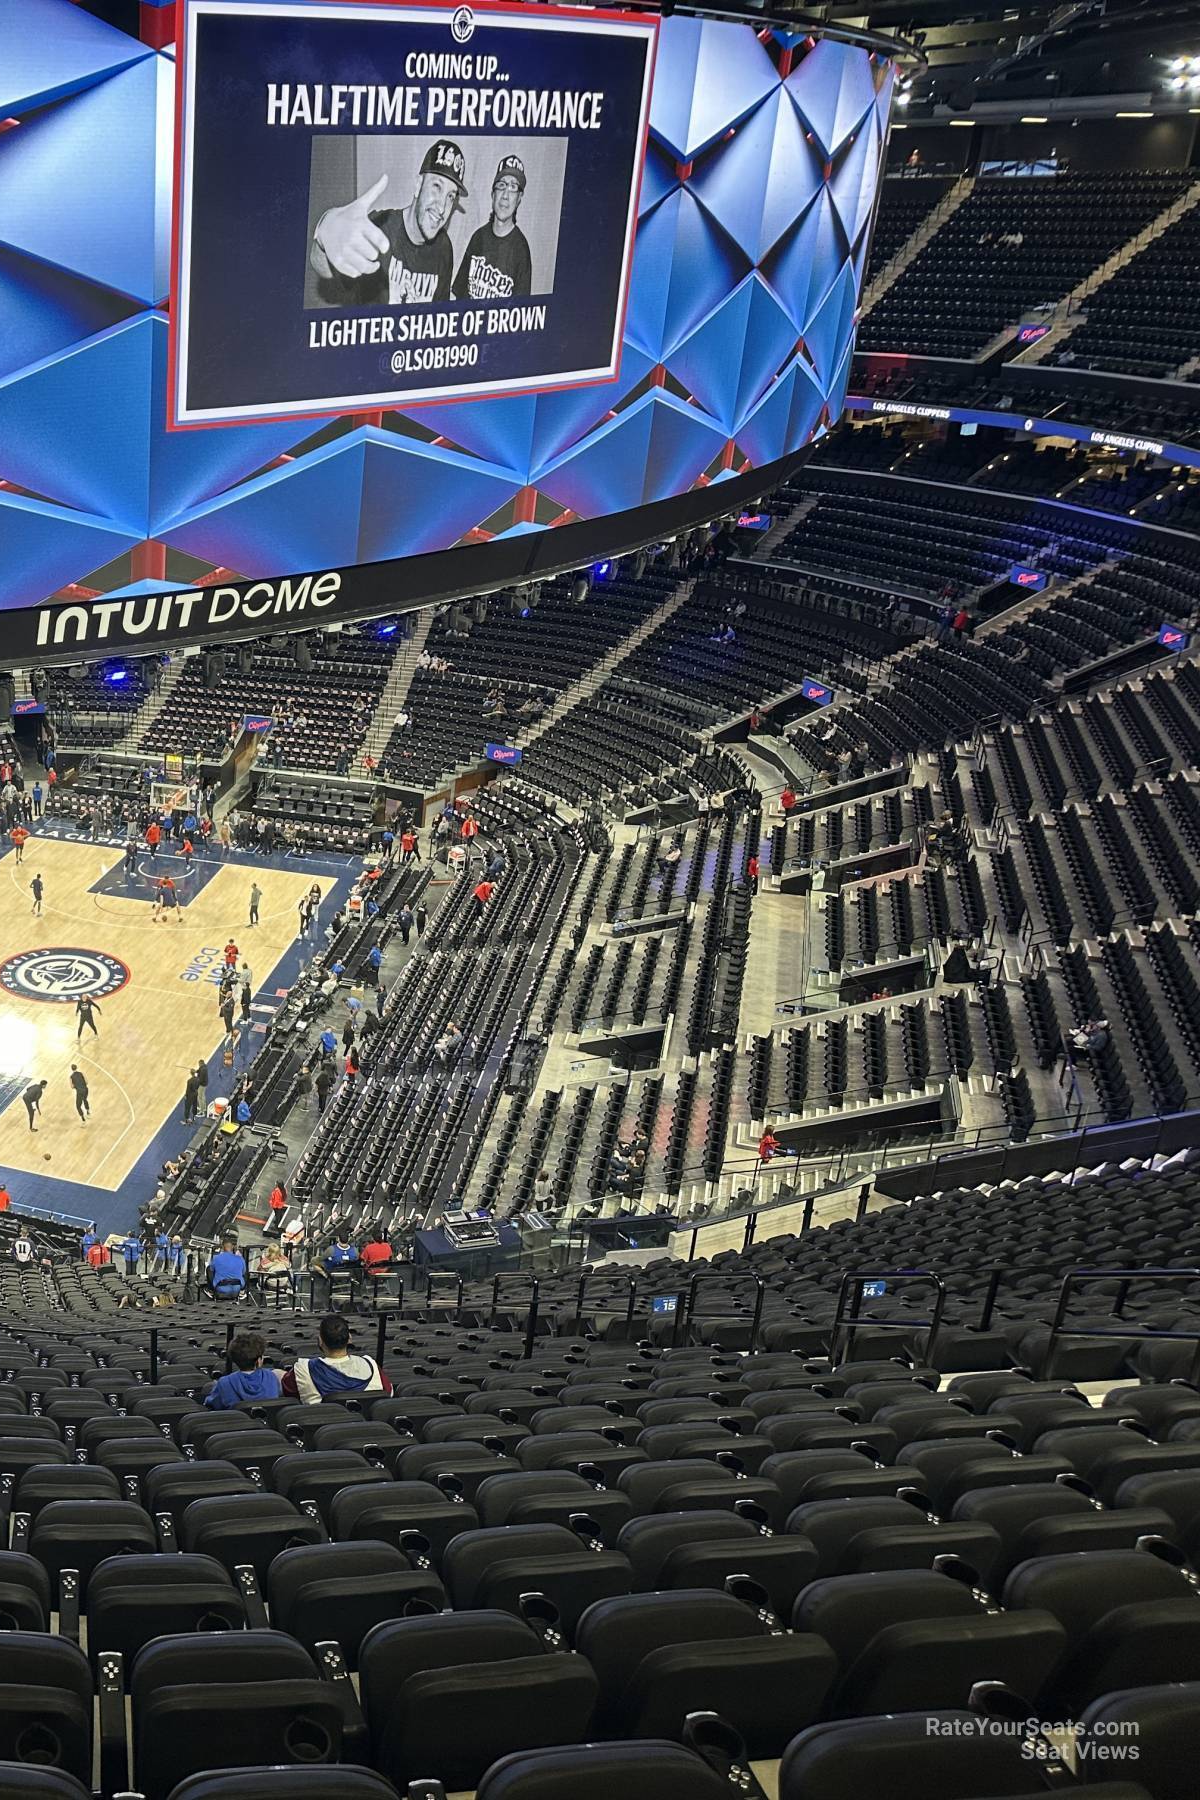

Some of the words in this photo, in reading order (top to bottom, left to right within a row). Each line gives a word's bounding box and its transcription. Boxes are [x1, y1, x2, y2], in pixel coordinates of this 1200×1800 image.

[405, 52, 473, 80] COMING
[267, 83, 421, 126] HALFTIME
[426, 87, 604, 130] PERFORMANCE
[309, 316, 394, 348] LIGHTER
[397, 312, 459, 342] SHADE
[462, 310, 485, 336] OF
[487, 305, 547, 334] BROWN
[391, 343, 479, 374] @LSOB1990
[872, 402, 887, 411] LOS
[886, 404, 916, 415] ANGELES
[1090, 431, 1105, 443] LOS
[36, 592, 204, 646] INTUIT
[207, 572, 341, 623] DOME
[35, 828, 59, 838] LA
[95, 954, 121, 970] LOS
[18, 1243, 27, 1254] 11
[863, 1288, 875, 1297] 14
[663, 1301, 676, 1311] 15
